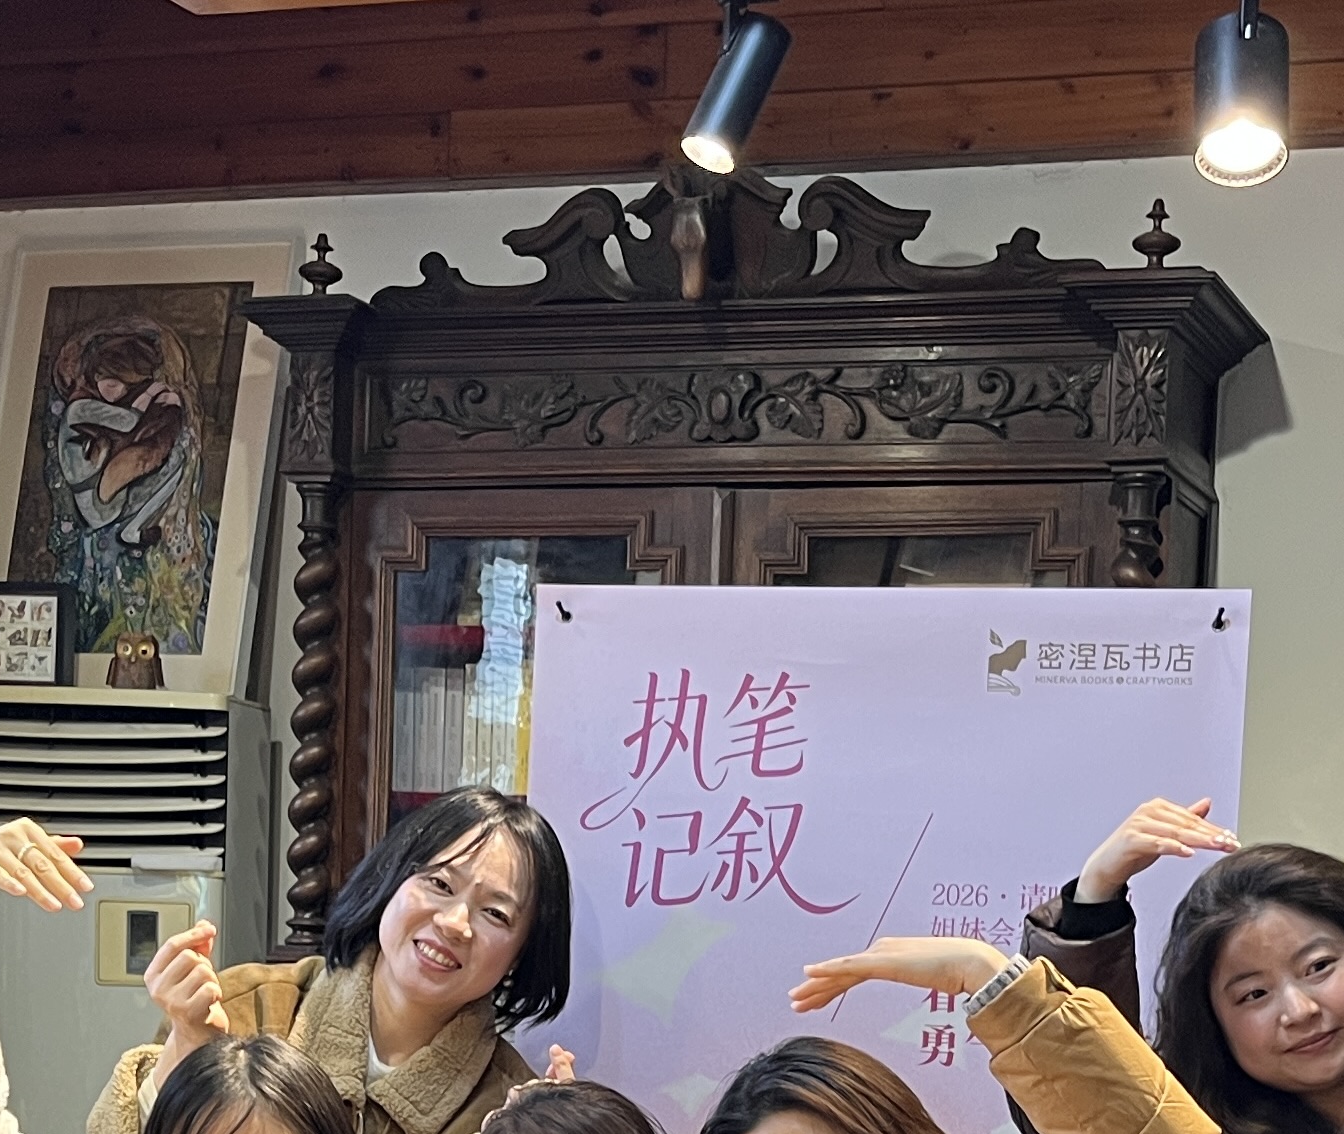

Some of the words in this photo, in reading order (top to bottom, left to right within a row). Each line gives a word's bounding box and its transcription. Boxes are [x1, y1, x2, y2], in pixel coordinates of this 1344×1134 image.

[1036, 641, 1195, 673] 密涅瓦书店
[1035, 675, 1078, 685] MINERVA
[1080, 676, 1114, 685] BOOKS
[1126, 677, 1194, 686] CRAFTWORKS
[623, 668, 810, 791] 执笔
[622, 796, 861, 914] 记叙
[931, 883, 988, 907] 2026
[931, 915, 1023, 946] 姐妹会
